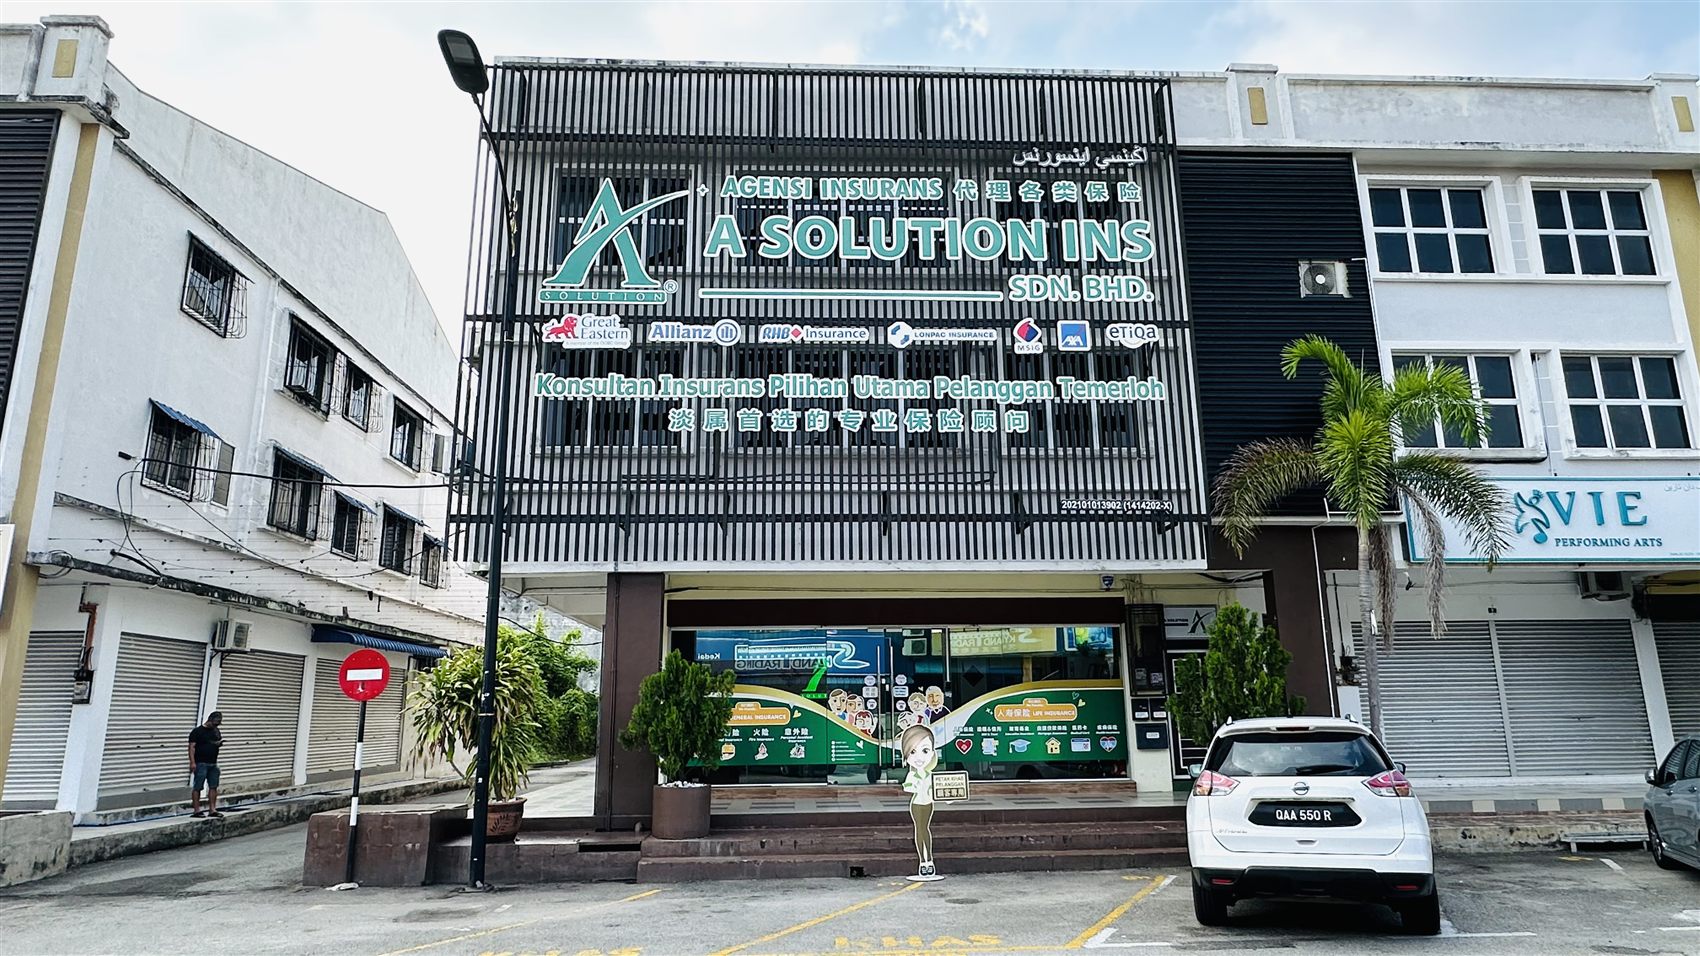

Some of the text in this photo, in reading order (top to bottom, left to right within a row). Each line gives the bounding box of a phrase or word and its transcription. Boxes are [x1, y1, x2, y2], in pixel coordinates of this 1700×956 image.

[721, 176, 942, 199] AGENSI INSURANS
[954, 180, 1141, 202] 代理各类保险
[704, 214, 1154, 262] A SOLUTION INS
[1008, 275, 1154, 302] SDN. BHD.
[544, 291, 663, 301] SOLUTION
[581, 316, 617, 327] Great
[580, 328, 628, 339] Eastern
[651, 324, 712, 339] Allianz
[762, 327, 866, 340] RHB Insurance
[1061, 335, 1084, 346] AXA
[536, 374, 1165, 403] Konsultan Insurans Pilihan Utama Pelanggan Temerloh
[669, 408, 1029, 432] 淡属首选的专业保险顾问
[1061, 500, 1173, 512] 202101013902 (1414202-X)
[1546, 490, 1648, 527] VIE
[1555, 537, 1663, 548] PERFORMING ARTS
[1275, 809, 1332, 821] QAA 550 R
